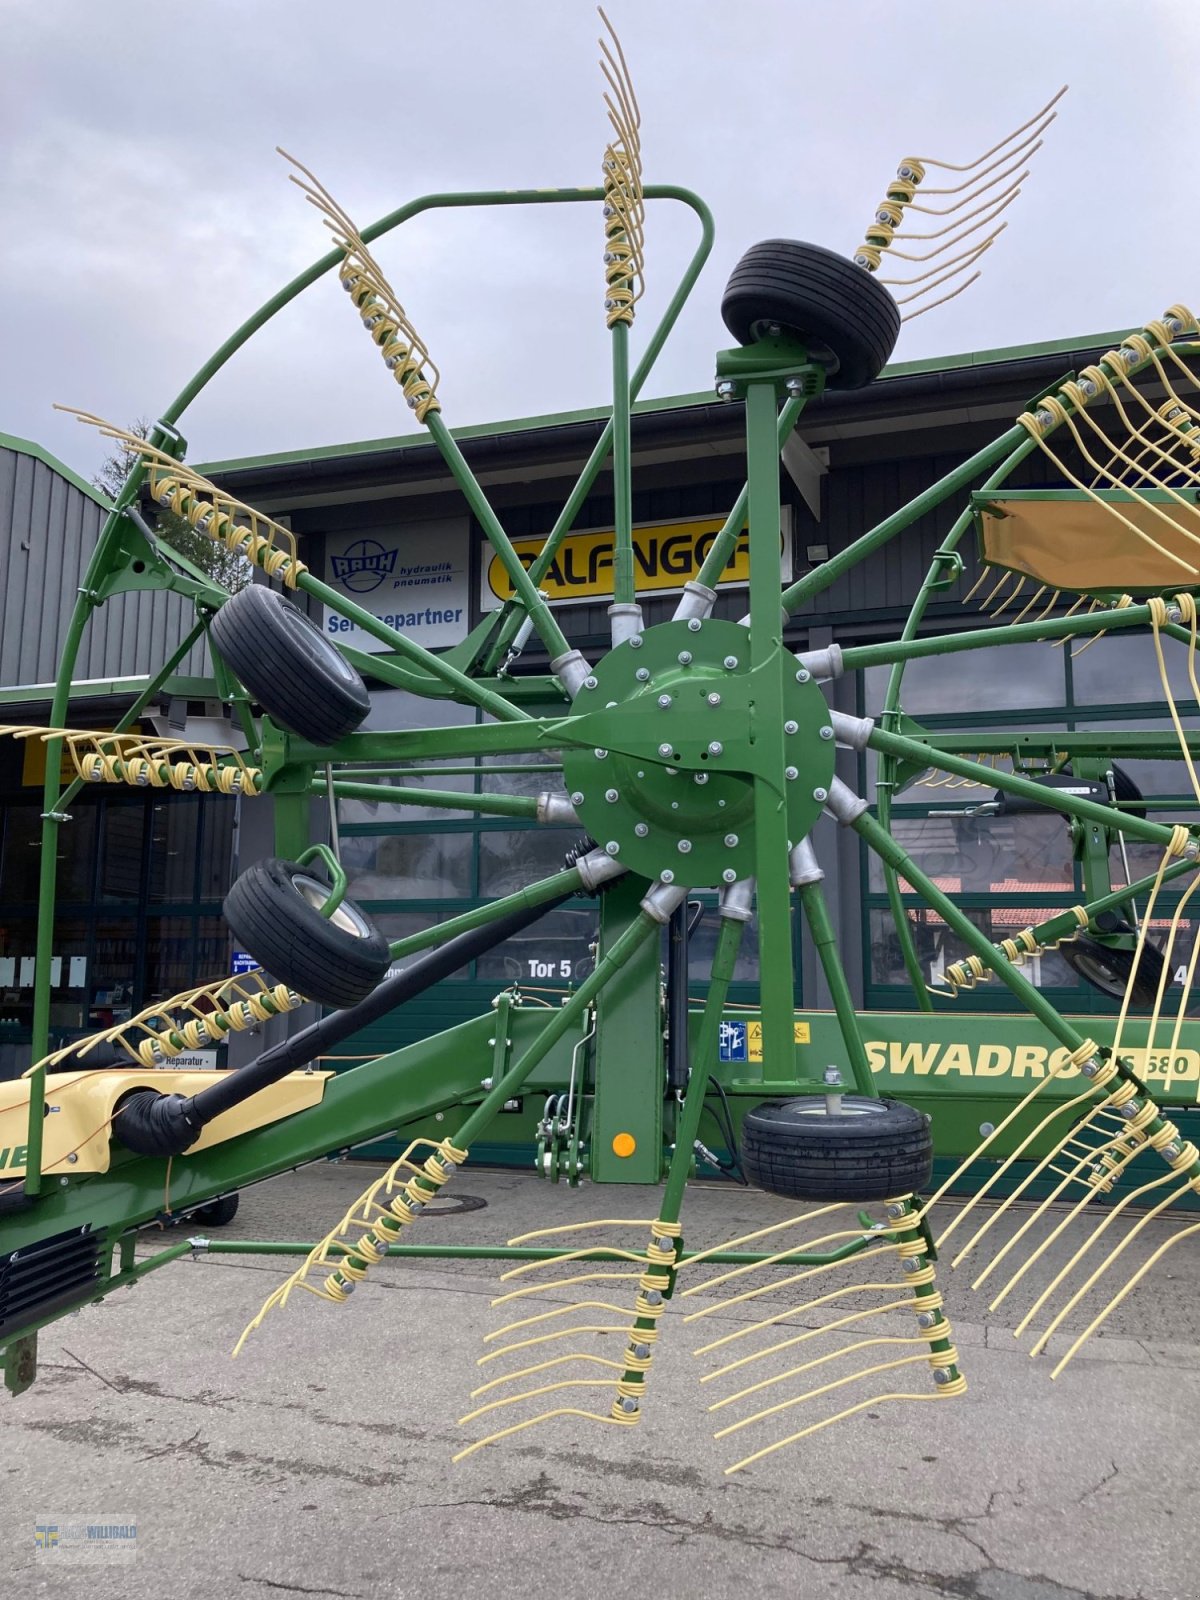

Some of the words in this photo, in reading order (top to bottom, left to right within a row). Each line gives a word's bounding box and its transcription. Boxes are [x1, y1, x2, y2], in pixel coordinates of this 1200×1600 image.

[400, 562, 453, 575] hydraulik
[393, 575, 453, 589] pneumatik
[528, 959, 556, 978] Tor
[560, 959, 571, 978] 5
[1173, 965, 1188, 986] 4
[165, 1056, 204, 1067] Reparatur
[863, 1041, 1082, 1079] SWADRO
